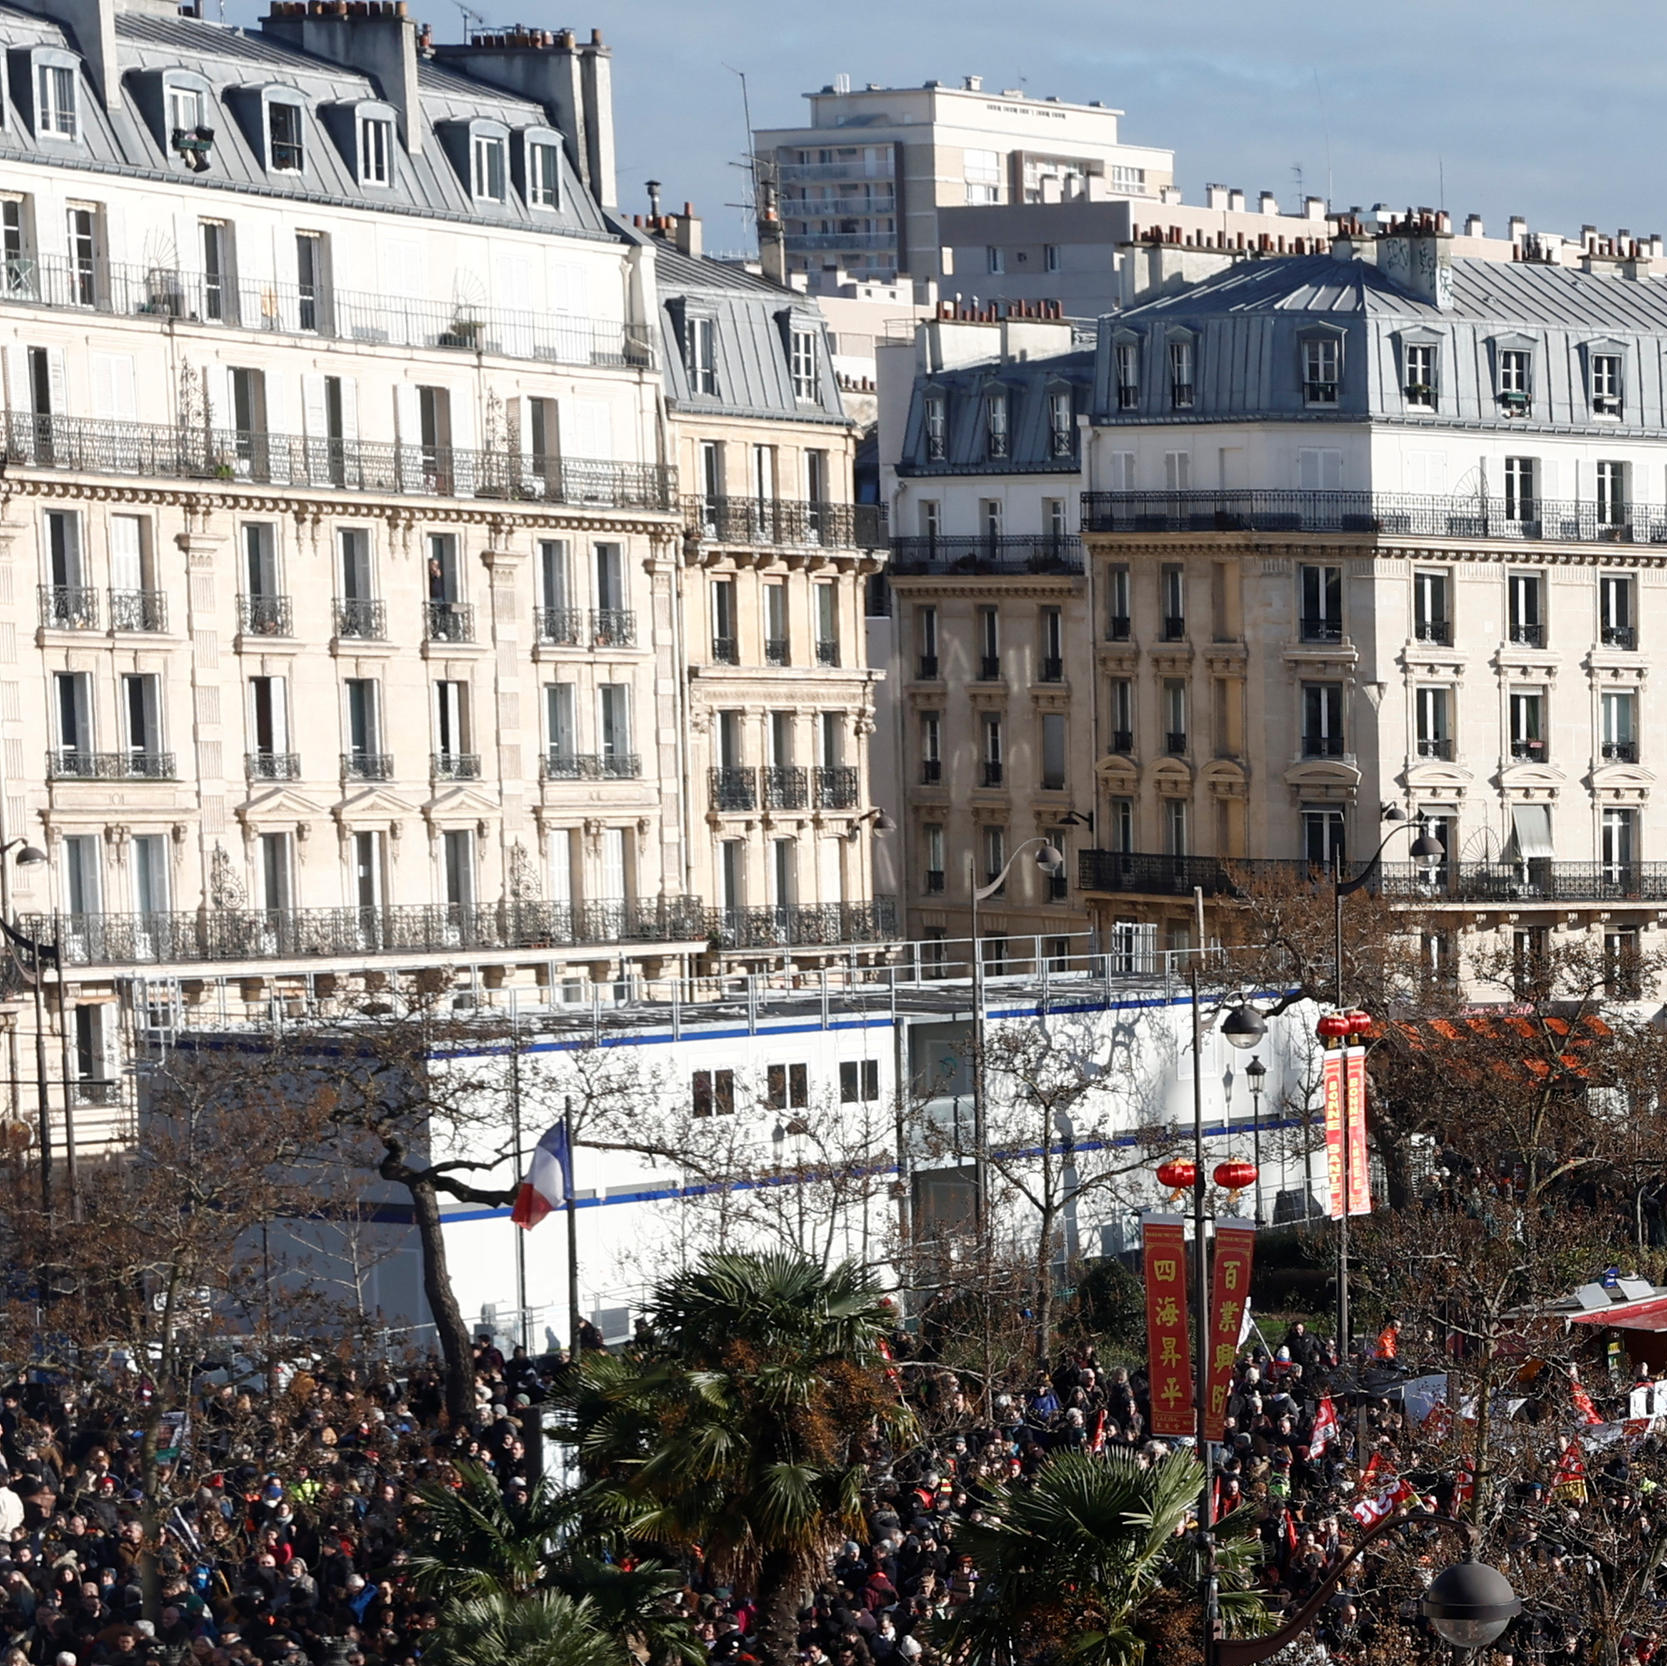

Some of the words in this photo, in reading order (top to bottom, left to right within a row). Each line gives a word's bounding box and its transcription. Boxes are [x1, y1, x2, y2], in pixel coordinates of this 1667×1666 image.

[1328, 1080, 1341, 1131] BONNE
[1153, 1259, 1183, 1409] 四海昇平
